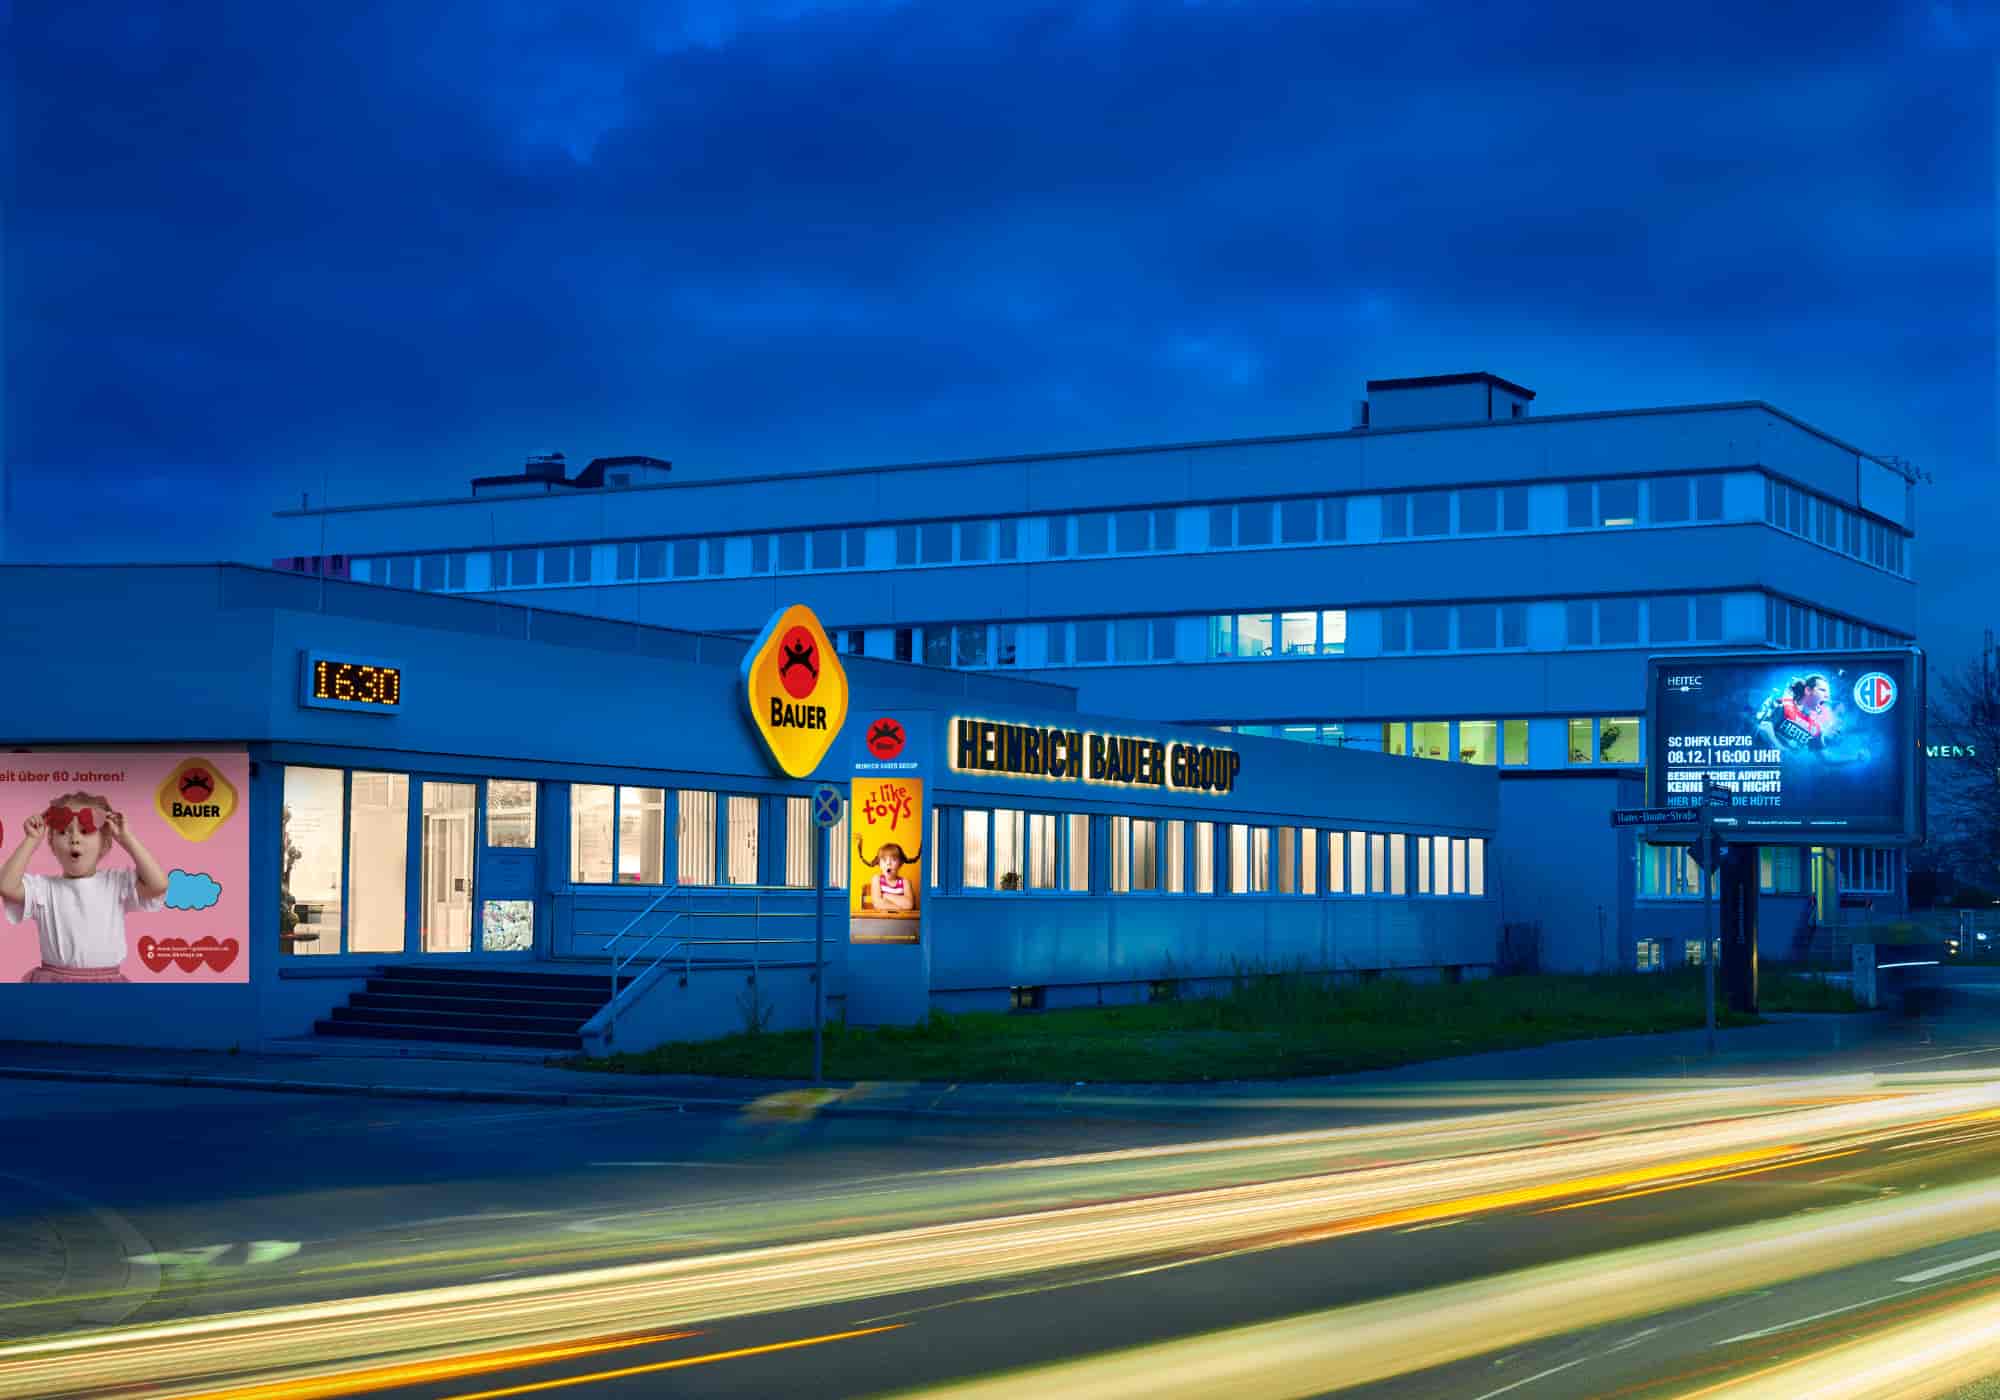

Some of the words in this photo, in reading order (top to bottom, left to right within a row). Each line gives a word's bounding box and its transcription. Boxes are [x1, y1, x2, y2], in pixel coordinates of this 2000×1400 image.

[1667, 676, 1703, 686] HEITEC
[770, 697, 827, 730] BAUER
[1667, 735, 1683, 747] SC
[1713, 735, 1753, 747] LEIPZIG
[955, 717, 1083, 779] HEINRICH
[1087, 733, 1166, 787] BAUER
[1169, 741, 1240, 792] GROUP
[1667, 749, 1706, 763] 08.12.
[1714, 749, 1752, 763] 16:00
[1753, 749, 1781, 763] UHR
[52, 770, 69, 782] 60
[71, 770, 125, 782] Jahren!
[1737, 770, 1781, 781] ADVENT?
[879, 783, 906, 802] like
[1742, 781, 1781, 793] NICHT!
[1731, 796, 1749, 806] DIE
[1750, 794, 1781, 807] HÜTTE
[172, 801, 221, 818] BAUER
[862, 796, 913, 831] toys
